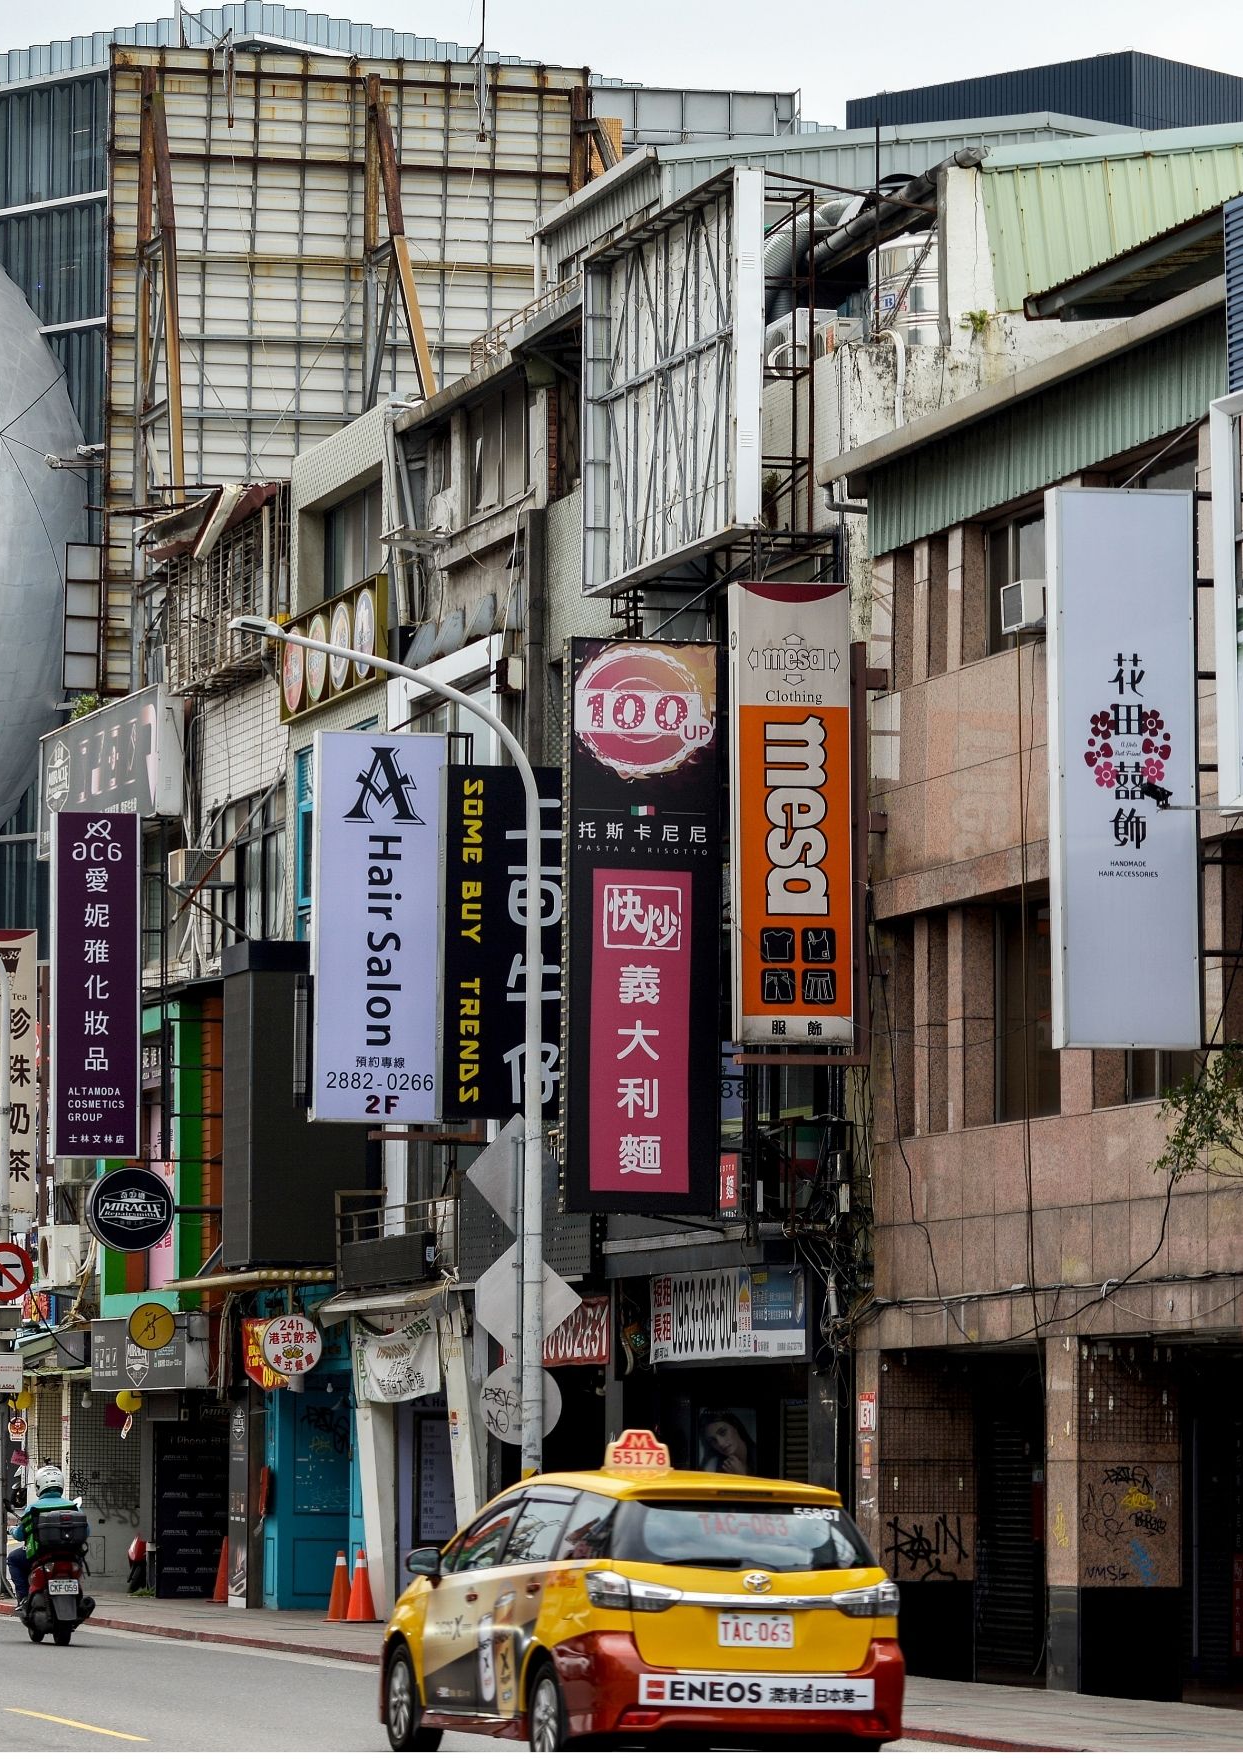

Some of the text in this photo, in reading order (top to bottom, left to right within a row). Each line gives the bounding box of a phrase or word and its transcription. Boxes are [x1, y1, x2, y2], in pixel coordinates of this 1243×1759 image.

[766, 689, 823, 705] Clothing
[587, 693, 688, 731] 100
[684, 725, 710, 741] UP
[342, 747, 426, 825] A
[763, 715, 830, 917] mesa
[578, 821, 707, 843] 托斯卡尼尼
[577, 845, 709, 856] PASTA & RISOTTO
[607, 888, 680, 948] 快炒
[366, 834, 402, 1047] Hair Salon
[459, 778, 483, 1103] SOME BUY TRENDS
[83, 867, 110, 1072] 愛妮雅化妝品
[12, 992, 27, 1001] Tea
[771, 1020, 823, 1037] 服飾
[355, 1056, 406, 1070] 預約專線
[617, 964, 663, 1177] 義大利麵
[326, 1072, 434, 1091] 2882-0266
[9, 1007, 31, 1182] 珍珠奶茶
[68, 1087, 121, 1097] ALTAMODA
[68, 1100, 125, 1109] COSMETICS
[365, 1095, 400, 1115] 2F
[68, 1113, 103, 1122] GROUP
[68, 1134, 125, 1145] 士林文林店
[101, 1202, 162, 1215] MIRACLE
[653, 1277, 672, 1308] 短租
[673, 1275, 737, 1354] 0953-365-604
[280, 1320, 304, 1331] 24h
[653, 1312, 672, 1343] 長租
[269, 1331, 318, 1345] 港式飲茶
[612, 1450, 666, 1466] 55178
[670, 1680, 763, 1703] ENEOS
